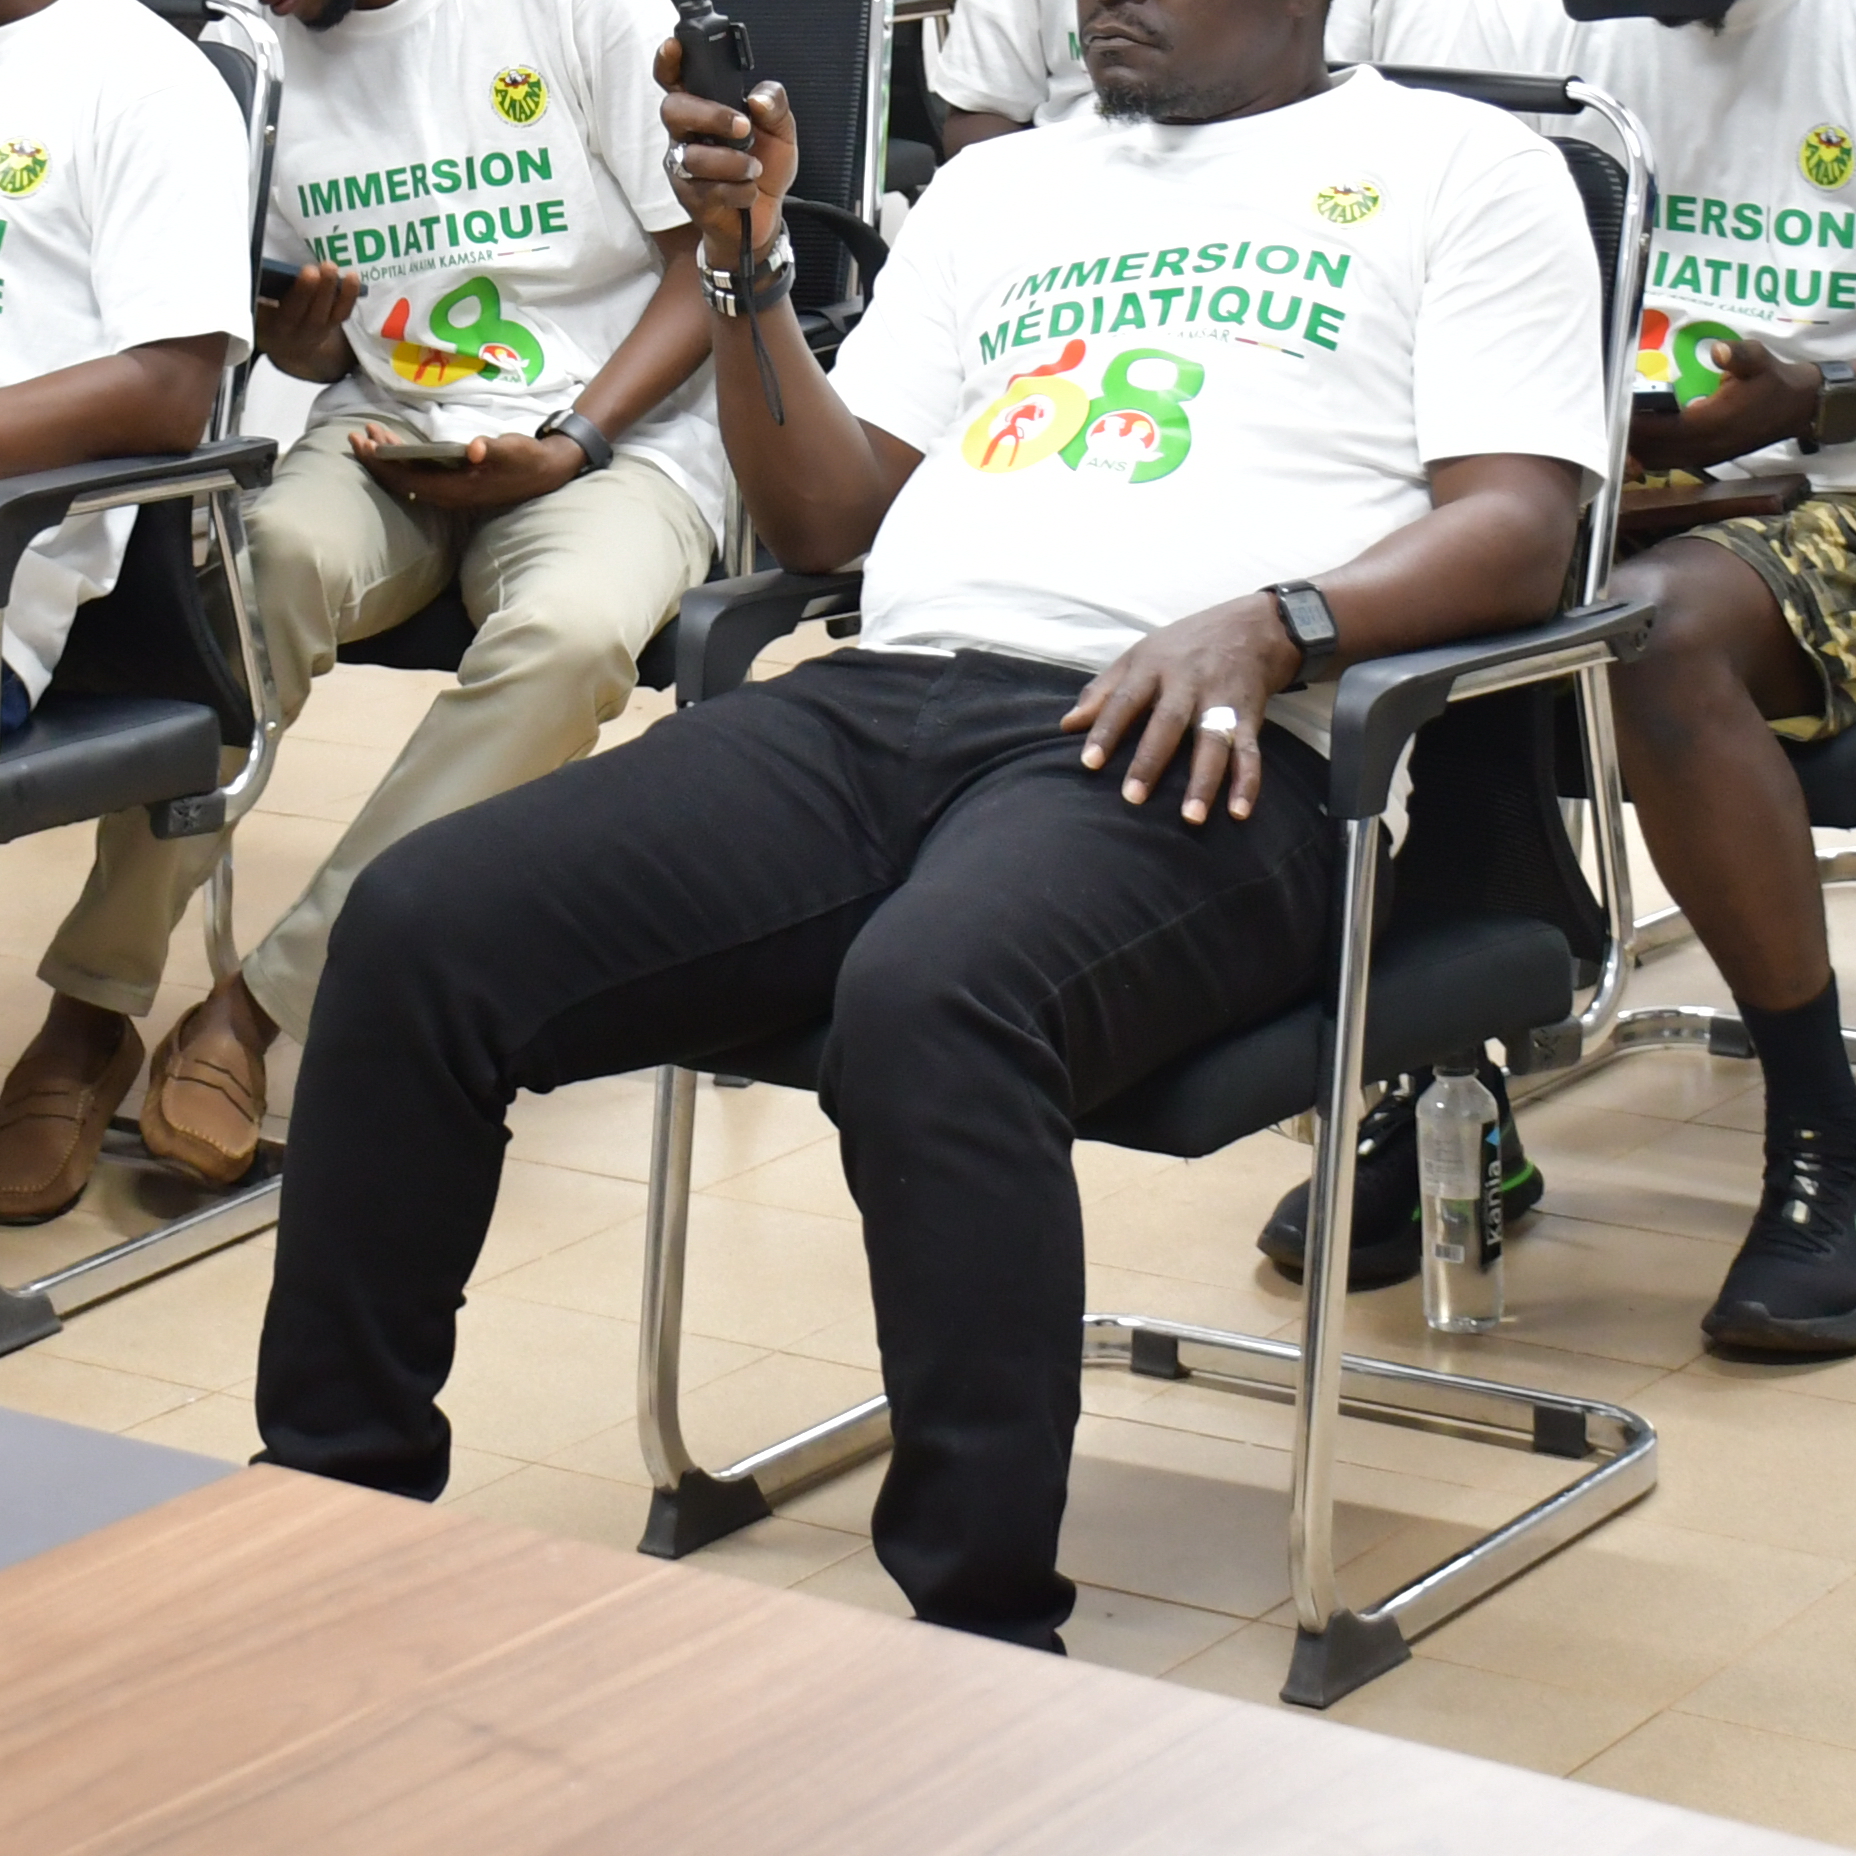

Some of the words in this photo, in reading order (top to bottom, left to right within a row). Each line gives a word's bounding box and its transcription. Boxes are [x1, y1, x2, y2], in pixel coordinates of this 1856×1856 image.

[494, 78, 542, 123] ANAIM
[298, 147, 554, 218] IMMERSION
[1317, 193, 1380, 224] ANAIM
[439, 249, 494, 269] KAMSAR
[1000, 240, 1352, 308] IMMERSION
[978, 284, 1347, 365] MÉDIATIQUE
[960, 338, 1206, 484] 68
